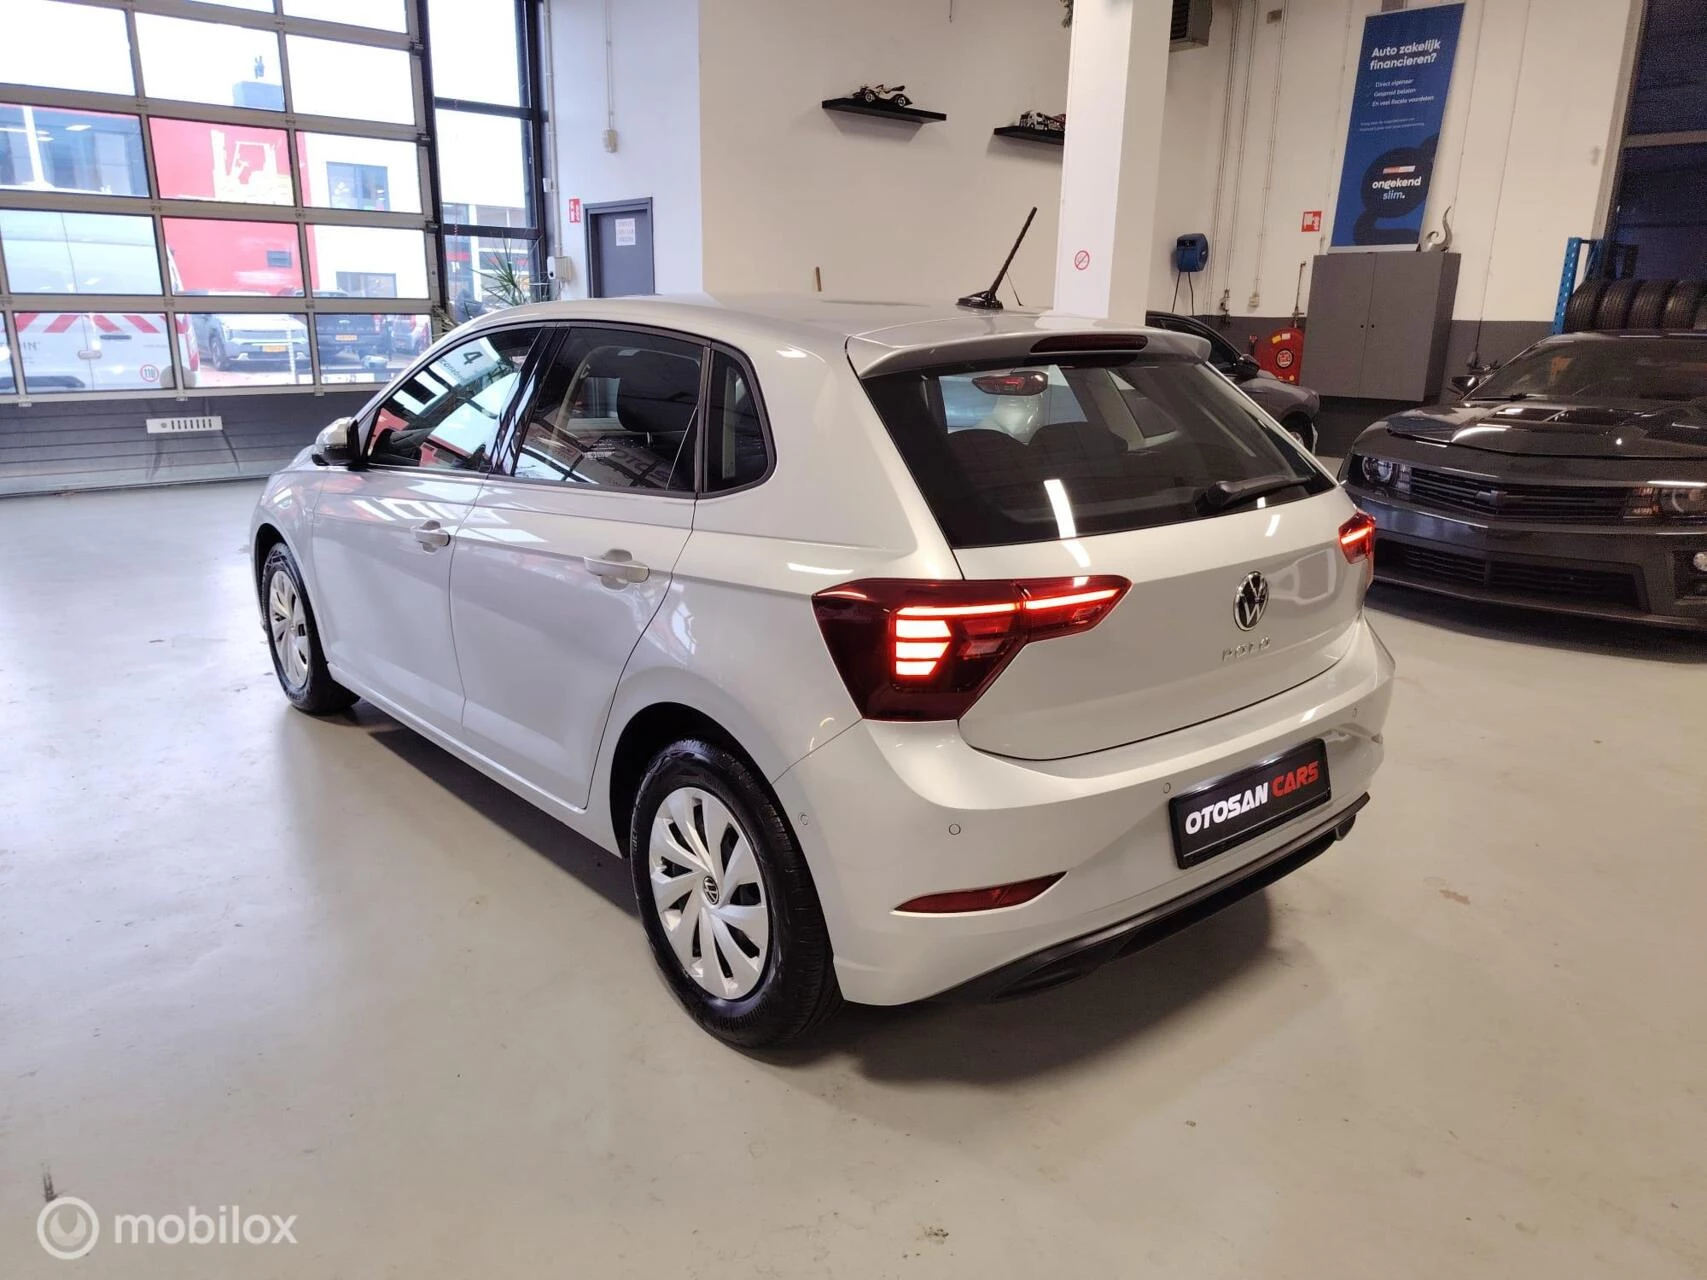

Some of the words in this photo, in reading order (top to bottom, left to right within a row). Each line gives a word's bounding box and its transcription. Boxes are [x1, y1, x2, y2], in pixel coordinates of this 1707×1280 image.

[1371, 47, 1398, 58] Auto
[1399, 38, 1441, 54] zakelijk
[1369, 52, 1437, 71] financieren?
[1372, 176, 1422, 190] ongekend
[1382, 190, 1406, 200] slim.
[1185, 782, 1269, 835] OTOSAN
[1271, 760, 1319, 797] CARS
